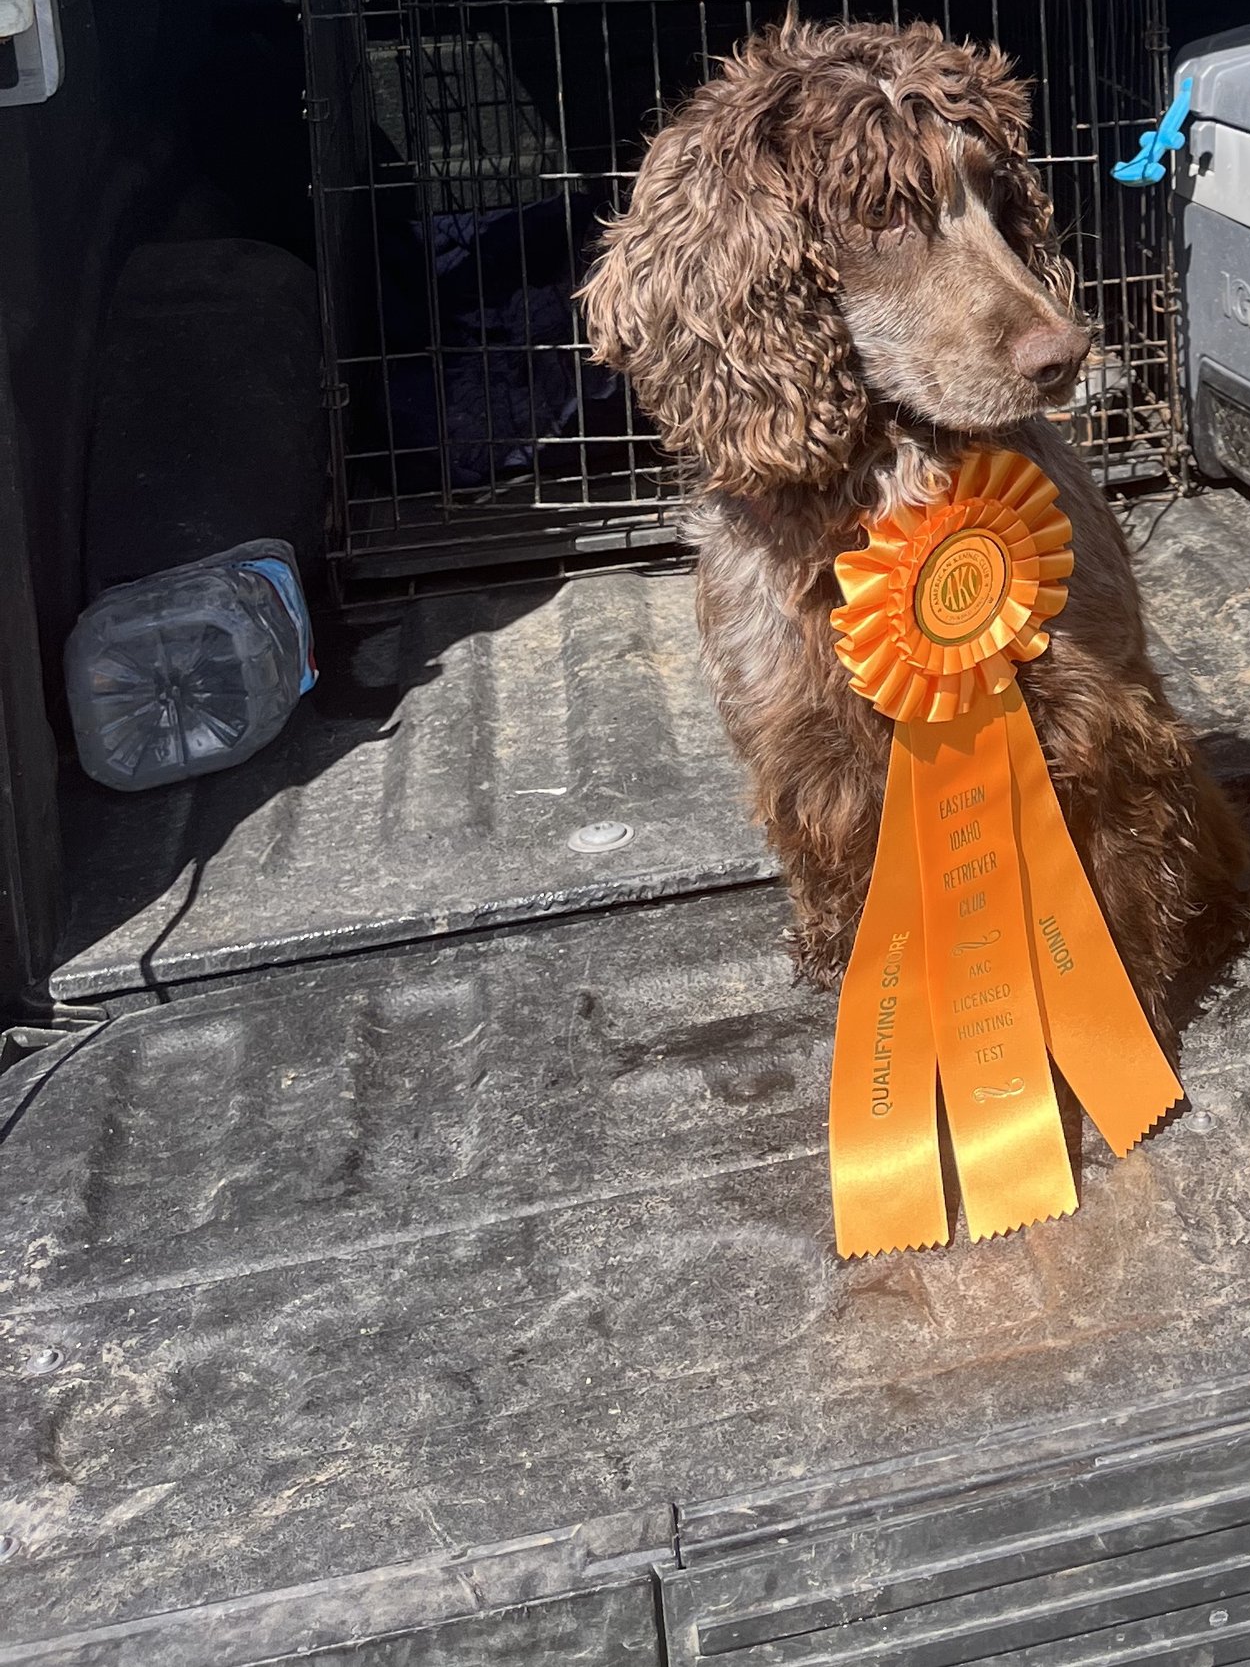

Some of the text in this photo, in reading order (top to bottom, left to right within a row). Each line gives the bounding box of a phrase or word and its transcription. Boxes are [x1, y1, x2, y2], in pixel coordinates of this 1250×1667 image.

[944, 565, 981, 611] AKC
[939, 784, 985, 820] EASTERN
[949, 819, 981, 851] IDAHO
[943, 850, 998, 891] RETRIEVER
[959, 891, 986, 918] CLUB
[1038, 915, 1074, 976] JUNIOR
[968, 959, 992, 979] AKC
[953, 983, 1011, 1014] LICENSED
[871, 931, 910, 1117] QUALIFYING SCORE
[957, 1011, 1014, 1041] HUNTING
[975, 1043, 1004, 1064] TEST
